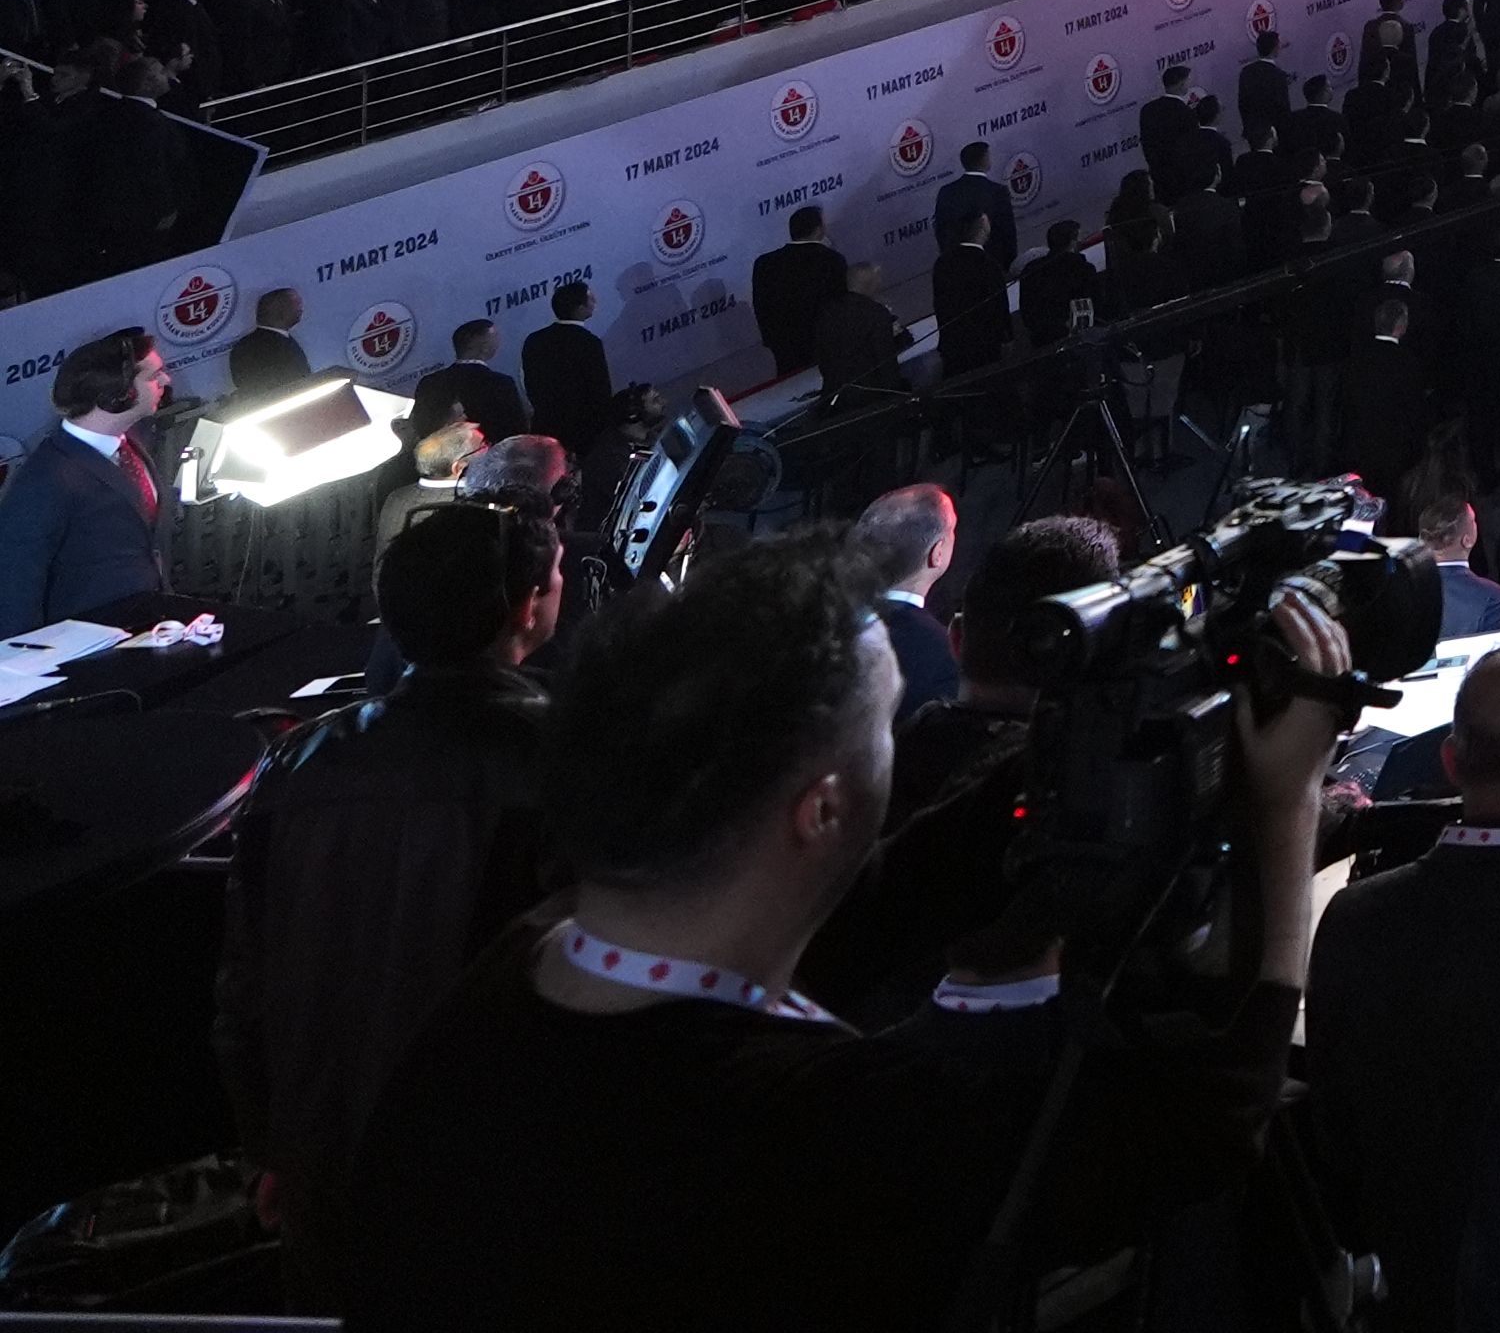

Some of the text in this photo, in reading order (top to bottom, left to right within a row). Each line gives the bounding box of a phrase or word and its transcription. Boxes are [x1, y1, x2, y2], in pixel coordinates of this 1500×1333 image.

[1064, 4, 1129, 36] 17 MART 2024
[1306, 2, 1314, 17] 17
[1156, 40, 1216, 71] 17 MART 2024
[866, 64, 944, 101] 17 MART 2024
[977, 100, 1048, 136] 17 MART 2024
[625, 136, 721, 181] 17 MART 2024
[758, 173, 844, 217] 17 MART 2024
[883, 218, 929, 246] 17 MART
[316, 228, 440, 283] 17 MART 2024
[484, 264, 594, 316] 17 MART 2024
[641, 293, 737, 344] 17 MART 2024
[5, 348, 66, 385] 2024
